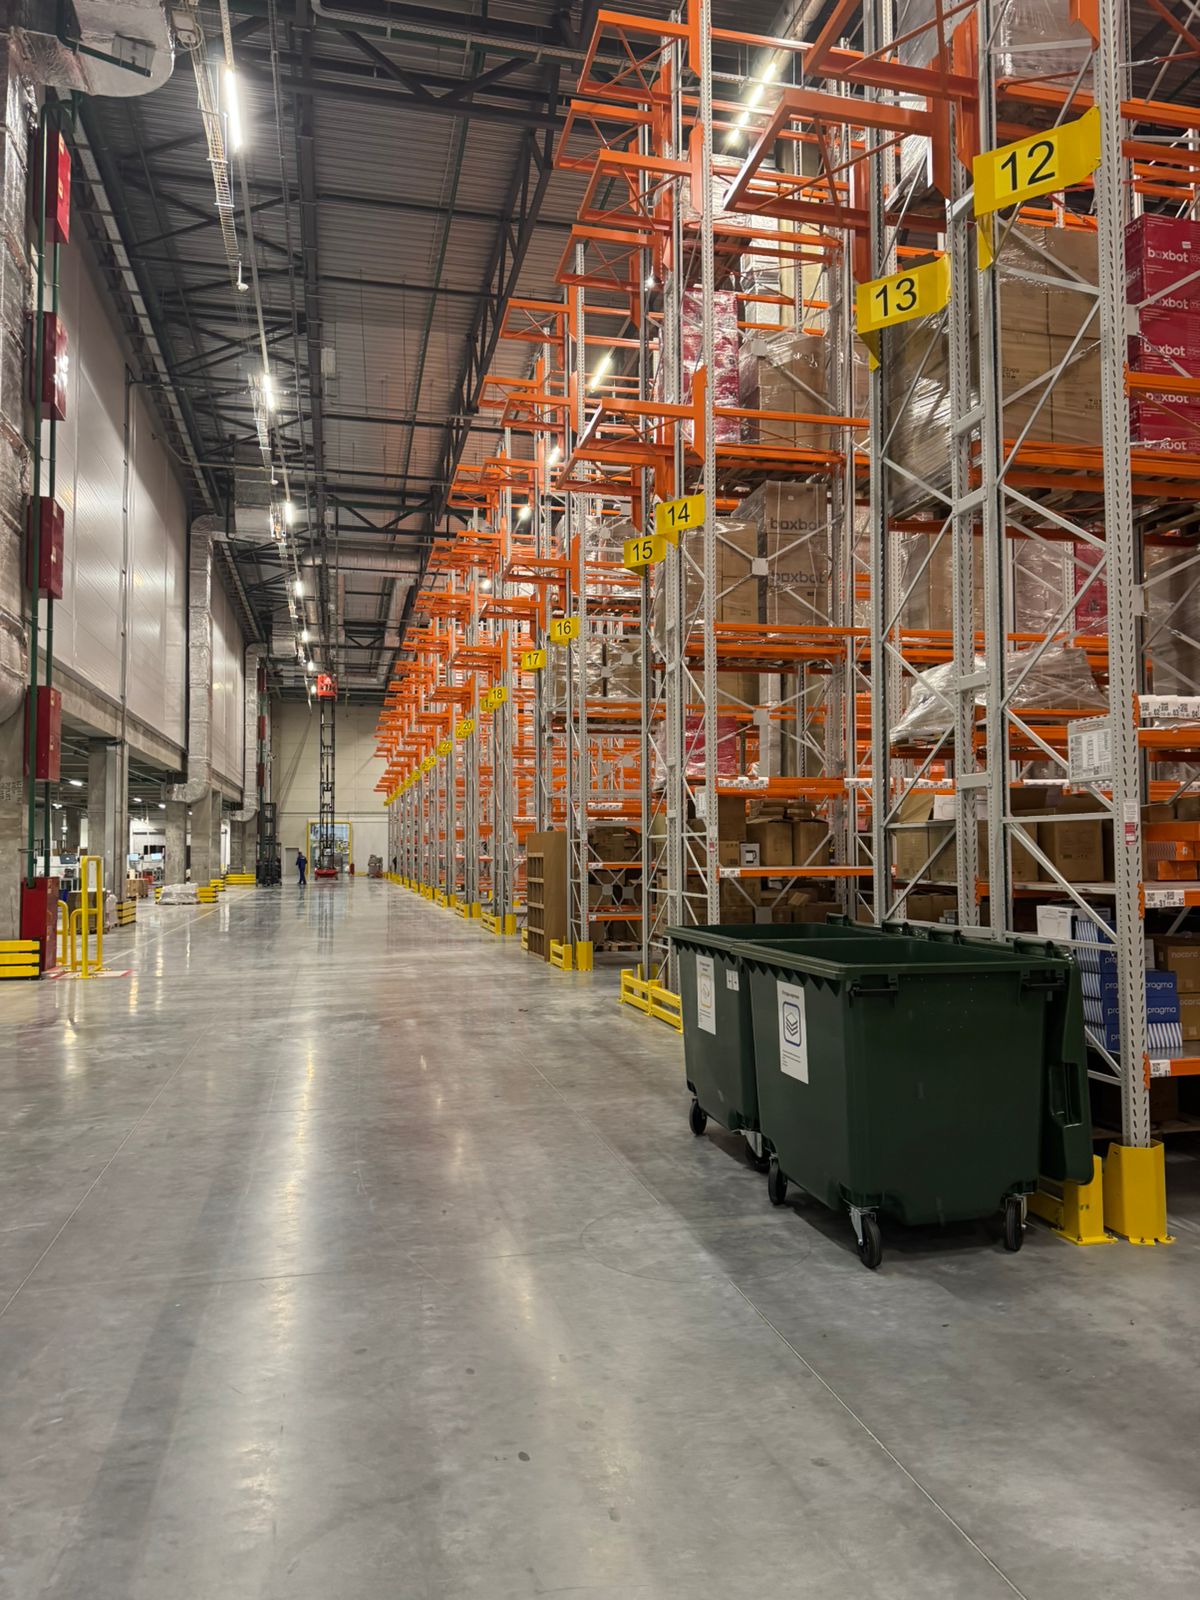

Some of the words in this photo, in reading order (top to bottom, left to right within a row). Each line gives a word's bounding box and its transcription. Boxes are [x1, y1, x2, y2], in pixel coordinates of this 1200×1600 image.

[1000, 140, 1056, 192] 12
[1147, 246, 1189, 263] boxbot
[875, 277, 917, 318] 13
[667, 502, 690, 526] 14
[632, 540, 653, 561] 15
[557, 620, 571, 636] 16
[527, 652, 540, 665] 17
[493, 689, 503, 699] 18
[463, 720, 472, 730] 20
[1147, 1007, 1177, 1015] pragma
